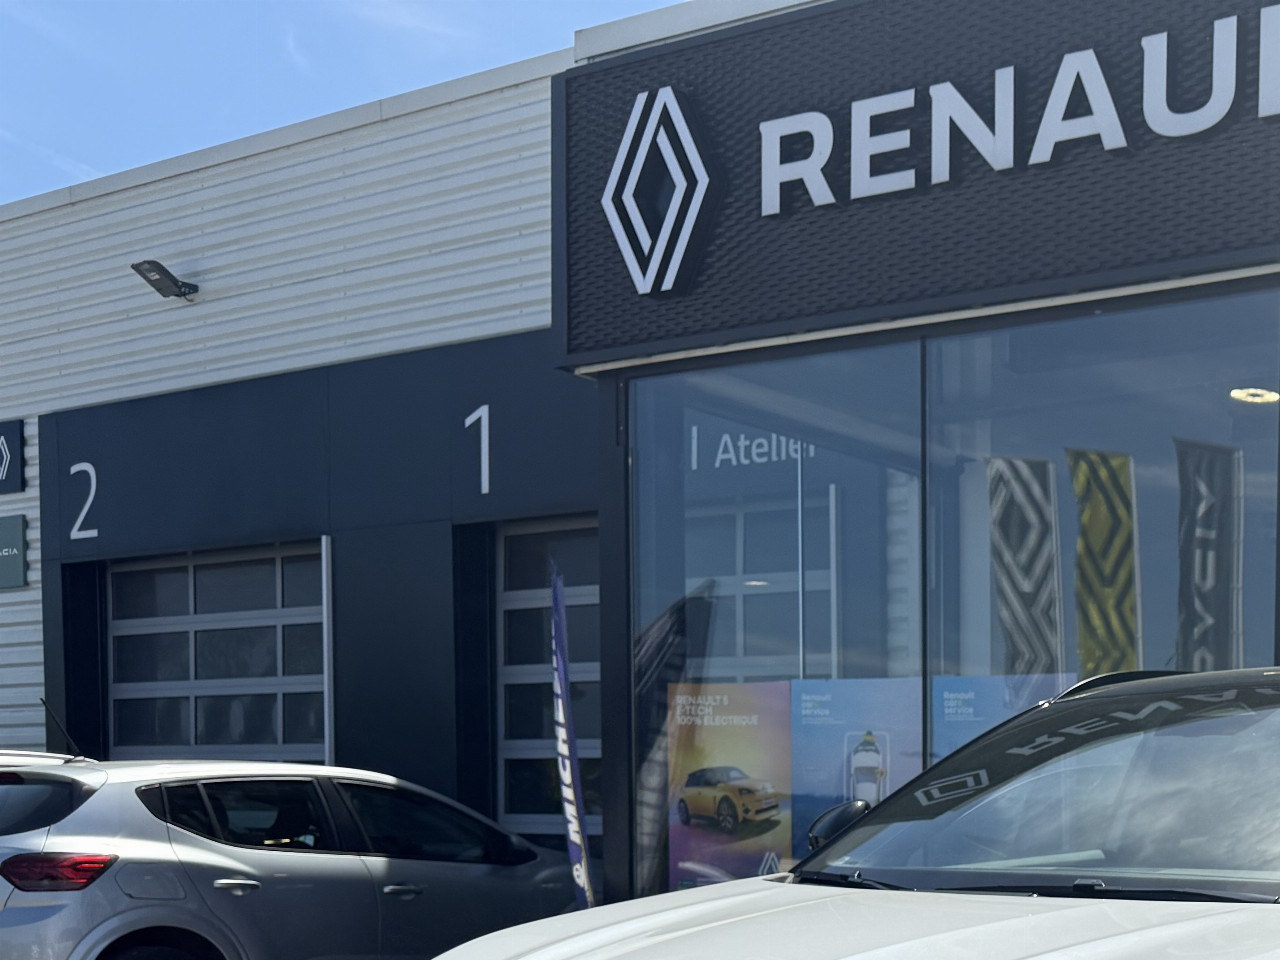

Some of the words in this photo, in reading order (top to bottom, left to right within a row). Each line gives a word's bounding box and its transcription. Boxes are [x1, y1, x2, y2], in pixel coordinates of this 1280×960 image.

[464, 405, 489, 494] 1
[68, 462, 99, 540] 2
[552, 618, 581, 845] MICH
